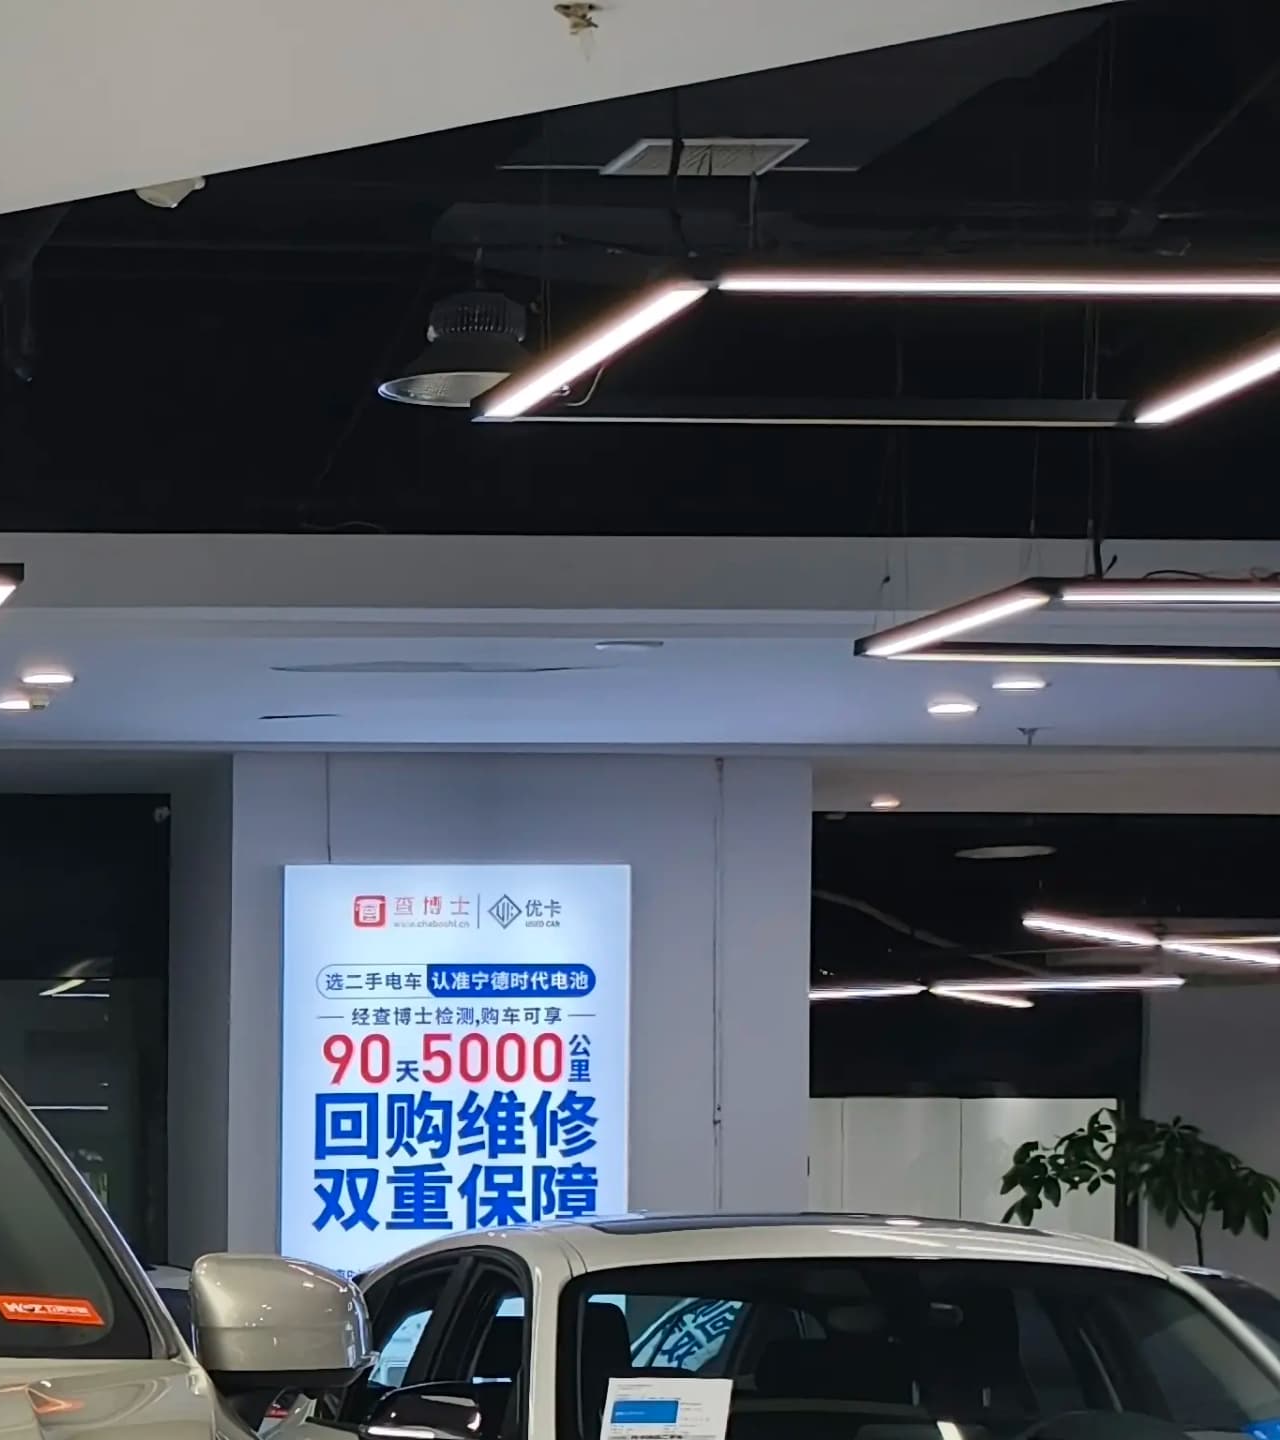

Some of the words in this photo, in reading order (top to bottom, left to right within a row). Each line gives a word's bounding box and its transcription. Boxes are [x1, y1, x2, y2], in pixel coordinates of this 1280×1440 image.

[525, 899, 562, 918] 优卡
[325, 973, 422, 992] 选二手电车
[432, 971, 589, 991] 认准宁德时代电池
[314, 1090, 598, 1160] 回购维修
[312, 1162, 598, 1232] 双重保障
